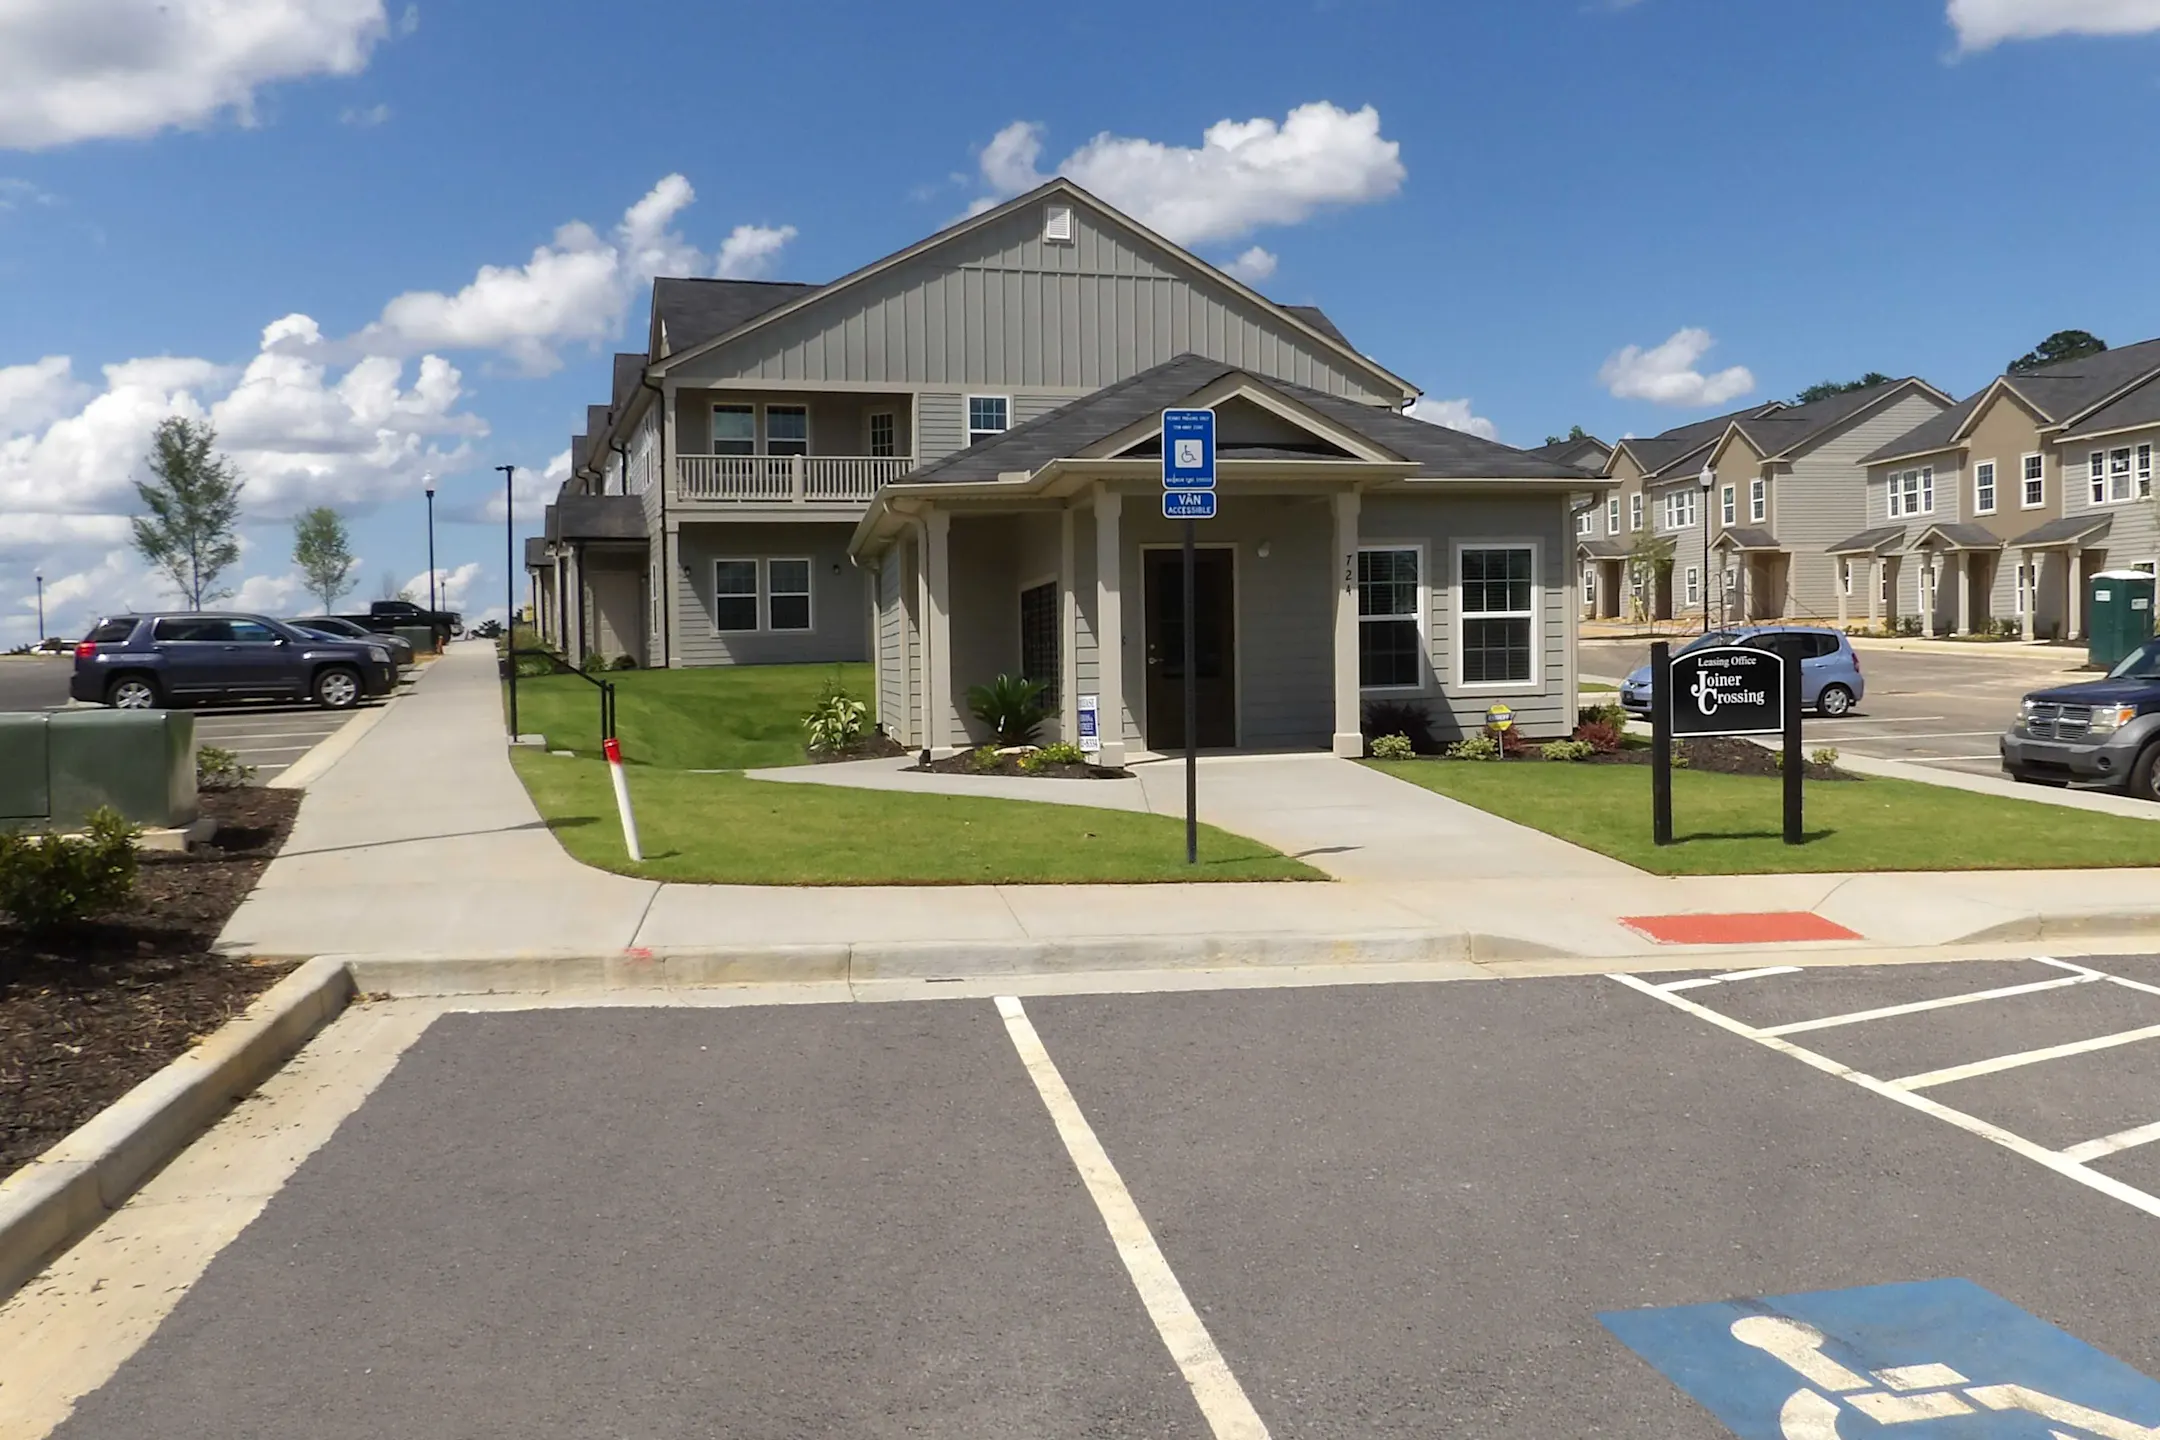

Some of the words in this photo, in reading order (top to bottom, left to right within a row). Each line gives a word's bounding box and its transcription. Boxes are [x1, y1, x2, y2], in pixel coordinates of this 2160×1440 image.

[1178, 494, 1202, 506] VAN
[1167, 506, 1212, 515] ACCESSIBLE
[1698, 657, 1730, 668] Leasing
[1730, 655, 1757, 666] Office
[1690, 670, 1742, 697] Joiner
[1697, 688, 1765, 716] Crossing
